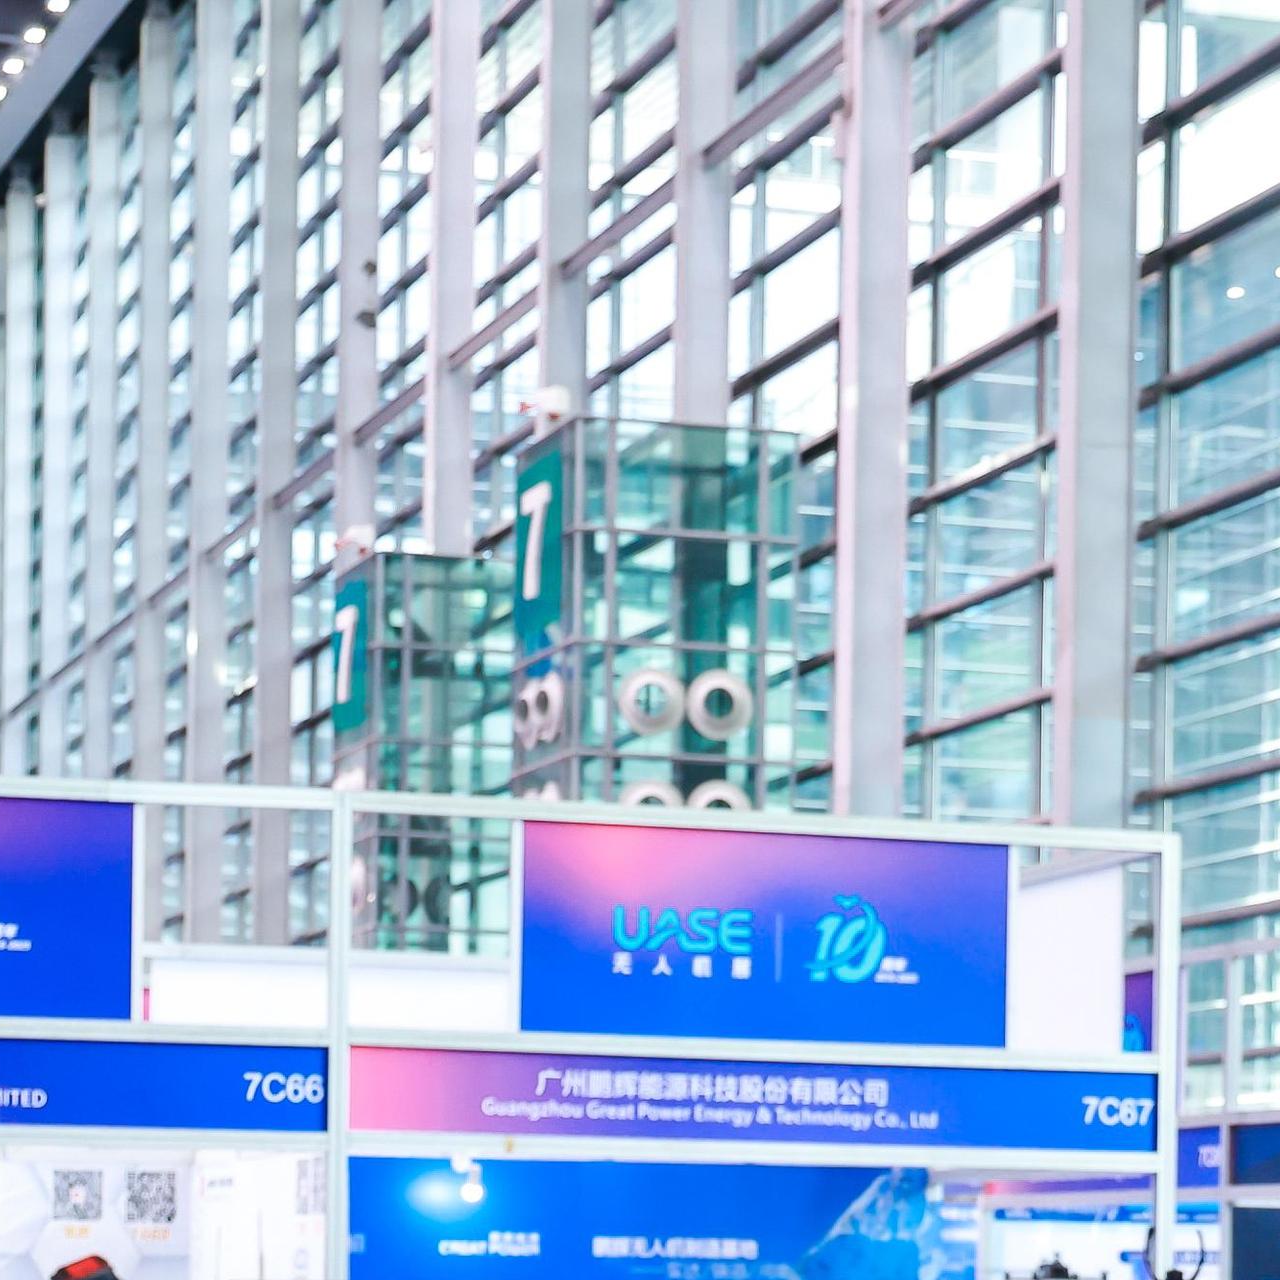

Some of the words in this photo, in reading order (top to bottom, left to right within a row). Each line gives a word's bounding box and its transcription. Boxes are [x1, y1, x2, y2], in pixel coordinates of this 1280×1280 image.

[612, 904, 754, 955] UASE
[243, 1070, 325, 1105] 7C66
[481, 1096, 583, 1122] Guangzhou
[586, 1098, 635, 1121] Great
[636, 1101, 691, 1123] Power
[693, 1103, 755, 1128] Energy
[756, 1108, 770, 1124] &
[775, 1106, 872, 1131] Technology
[1082, 1096, 1155, 1127] 7C67
